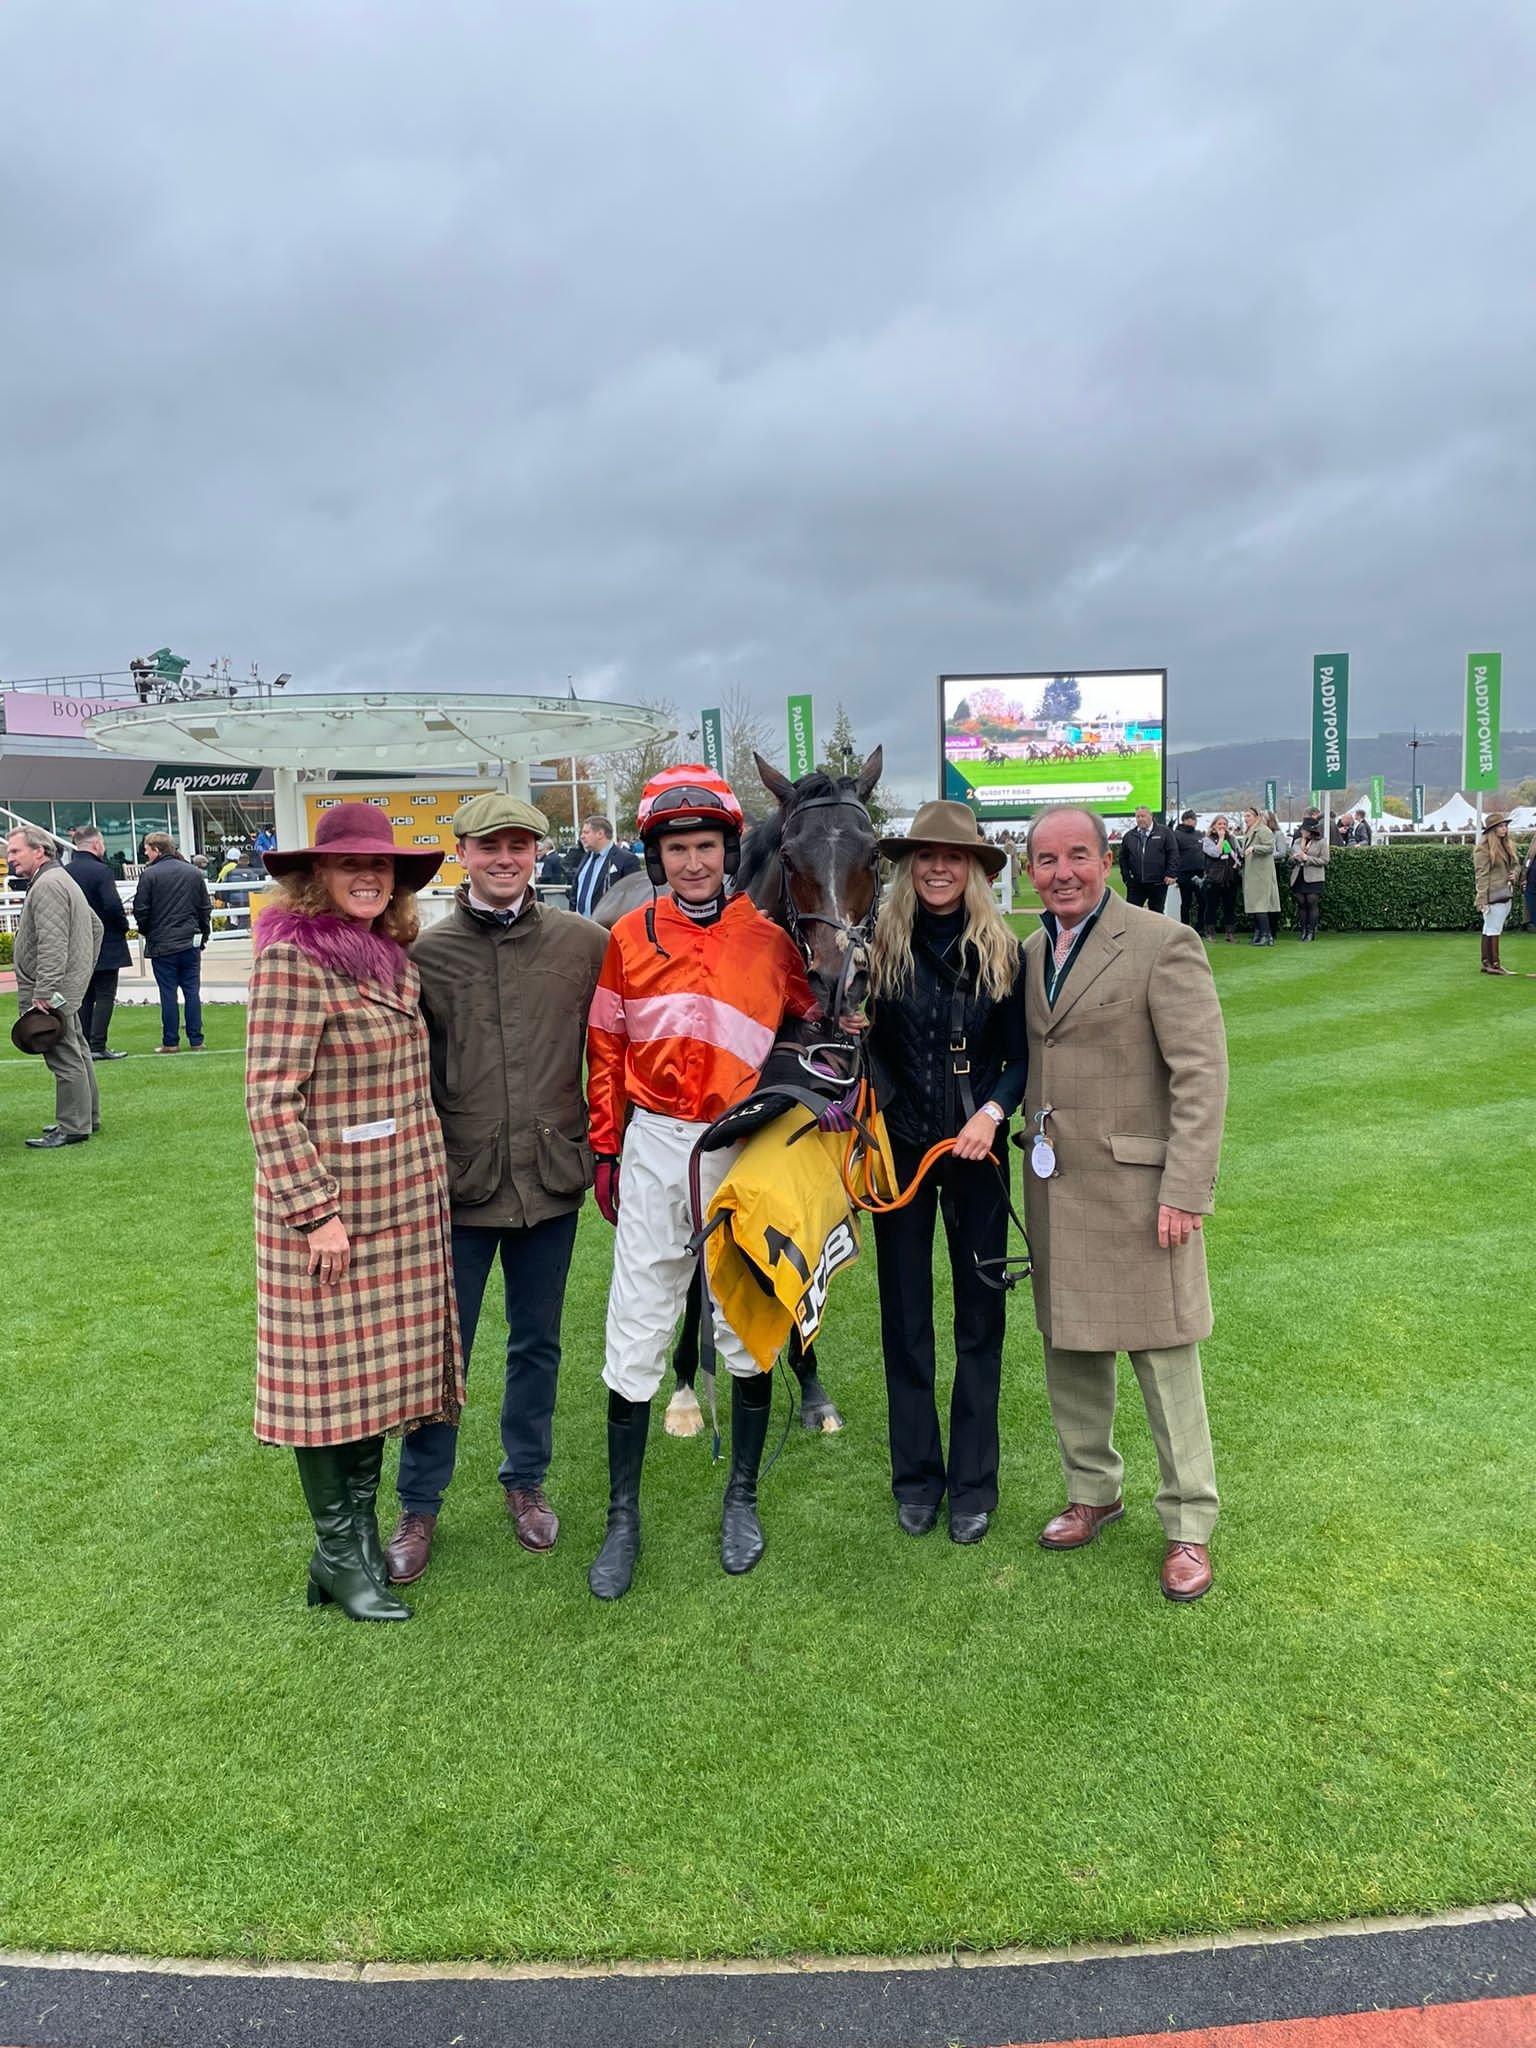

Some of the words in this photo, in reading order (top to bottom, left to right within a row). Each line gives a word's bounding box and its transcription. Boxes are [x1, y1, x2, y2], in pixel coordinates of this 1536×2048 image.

[411, 796, 437, 805] JCB
[391, 817, 414, 825] JCB
[437, 816, 453, 824] JC
[414, 836, 440, 845] JCB
[800, 1222, 856, 1338] JCB
